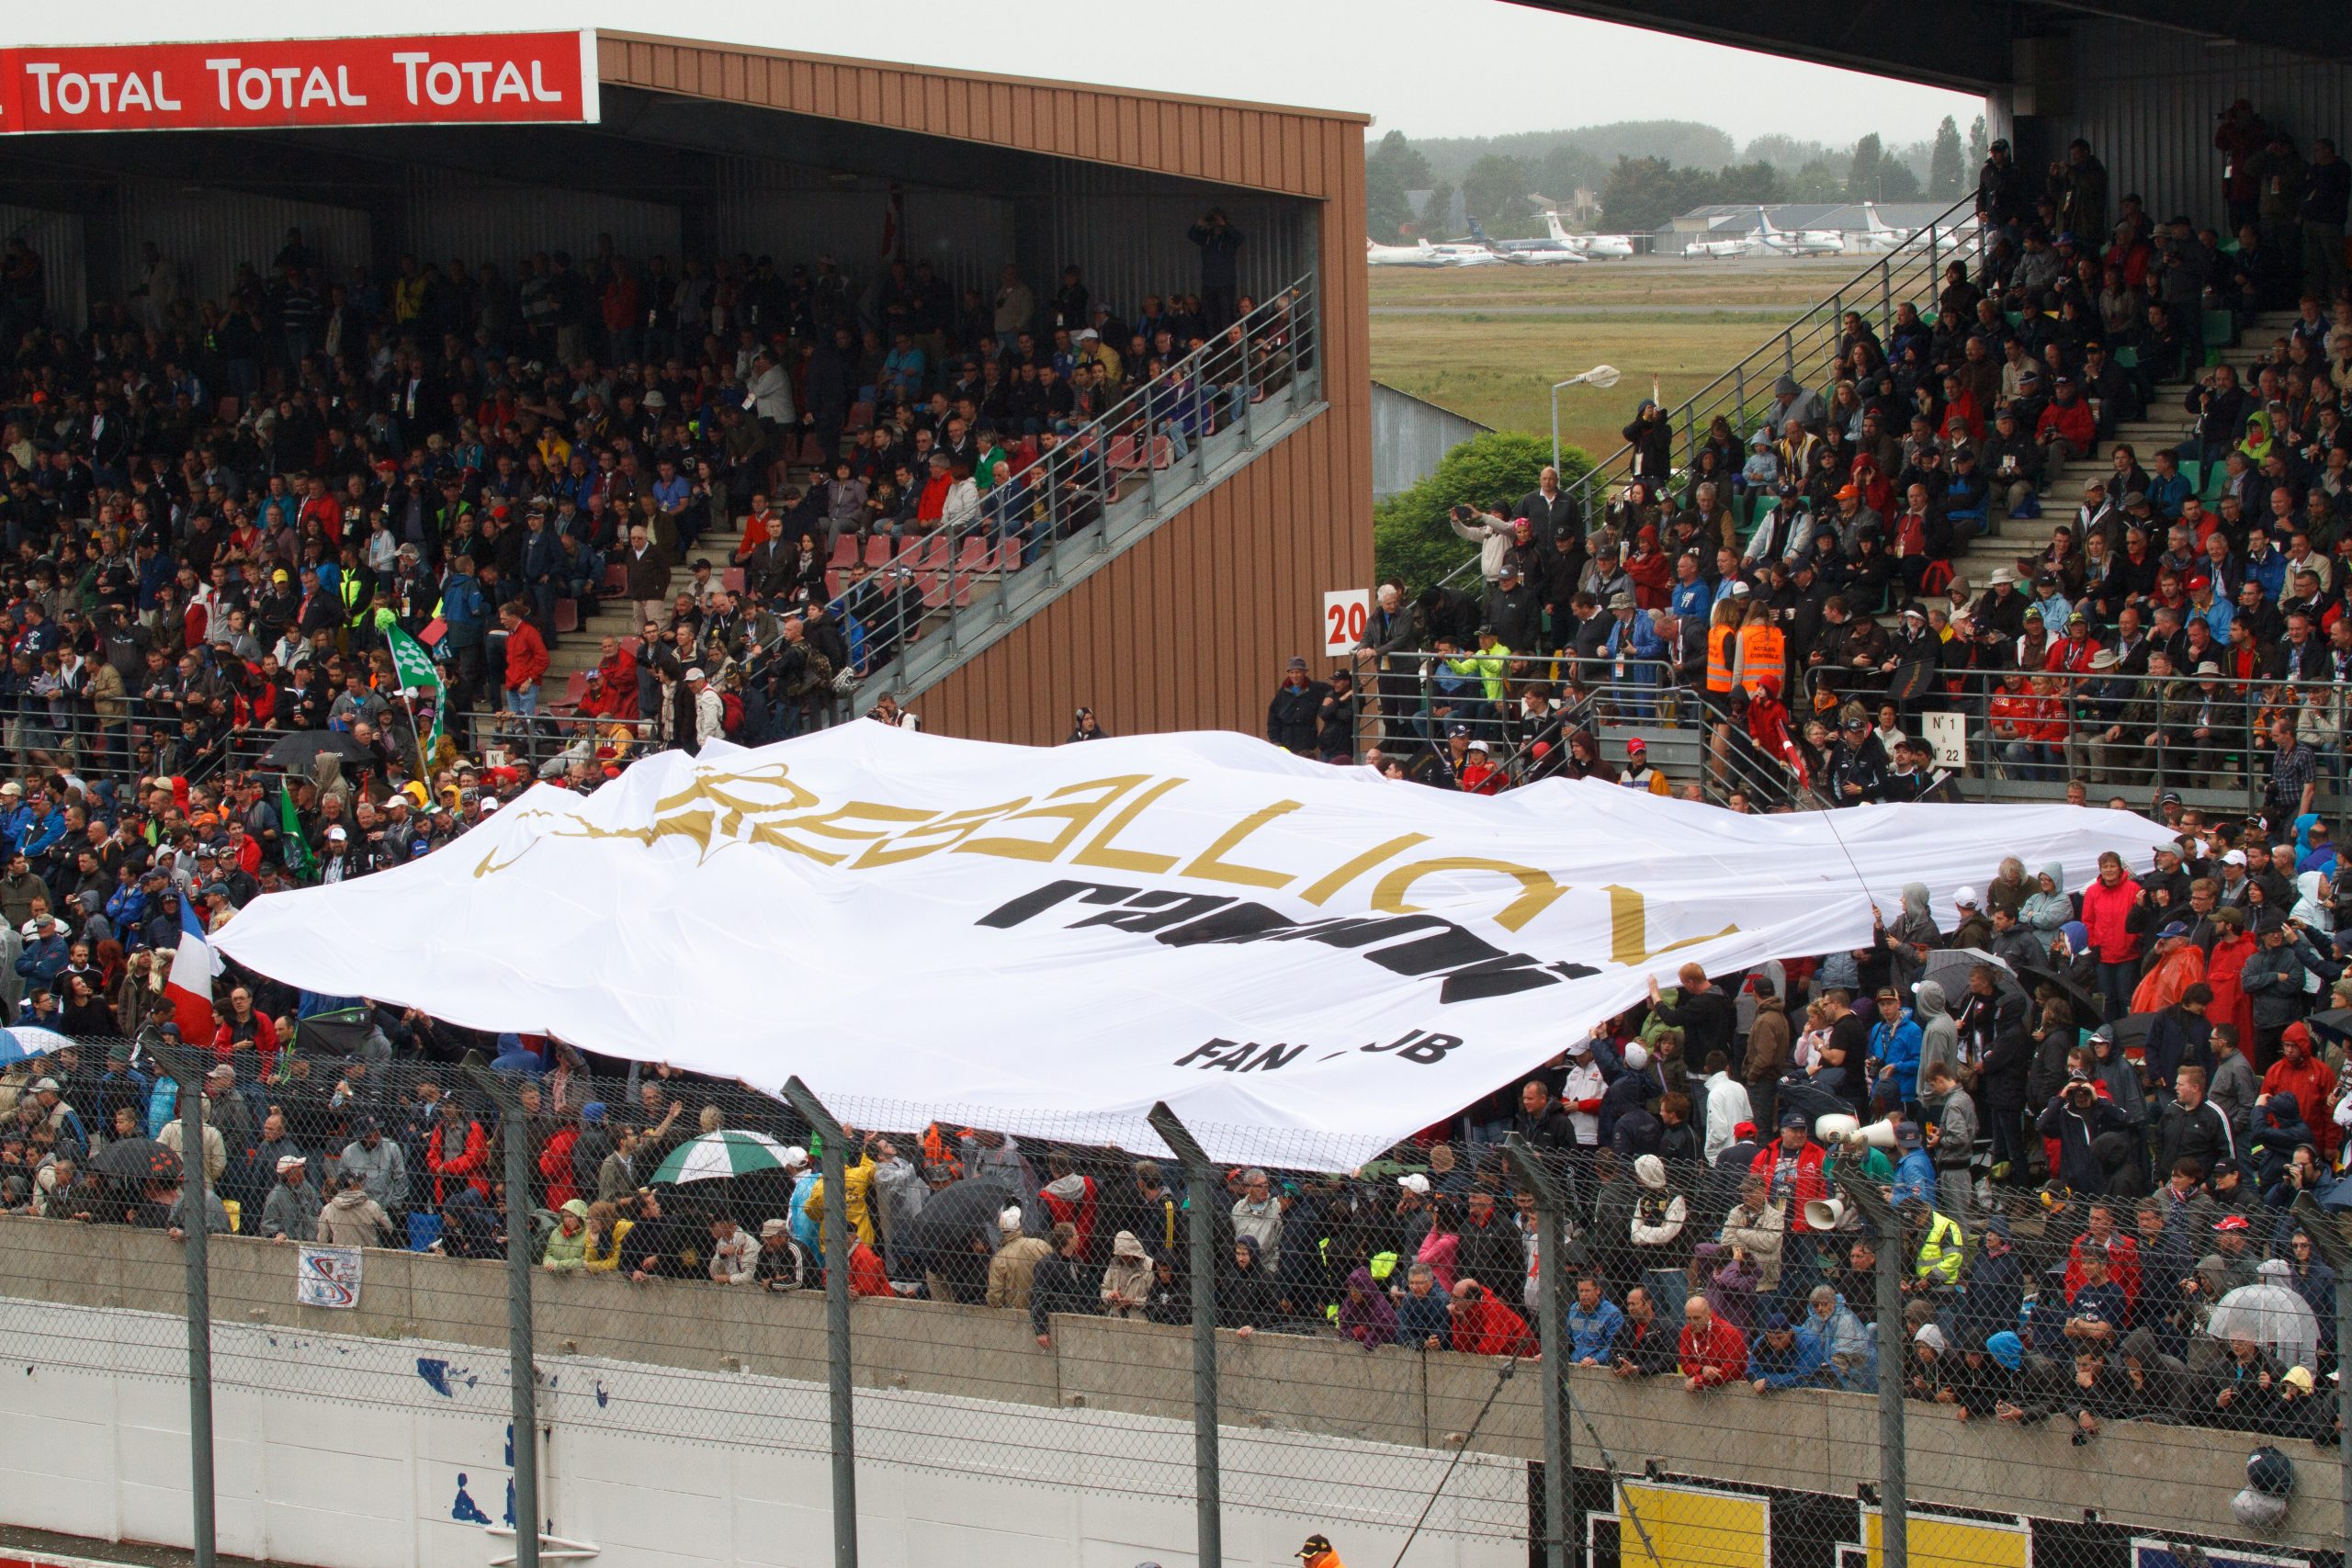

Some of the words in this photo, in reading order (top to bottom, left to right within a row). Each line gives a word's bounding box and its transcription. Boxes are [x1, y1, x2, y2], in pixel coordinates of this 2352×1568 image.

[26, 62, 182, 115] TOTAL
[206, 58, 368, 111] TOTAL
[392, 51, 562, 106] TOTAL
[1328, 602, 1367, 645] 20
[1950, 718, 1954, 730] 1
[1946, 750, 1959, 761] 22
[1172, 1037, 1310, 1073] FAN
